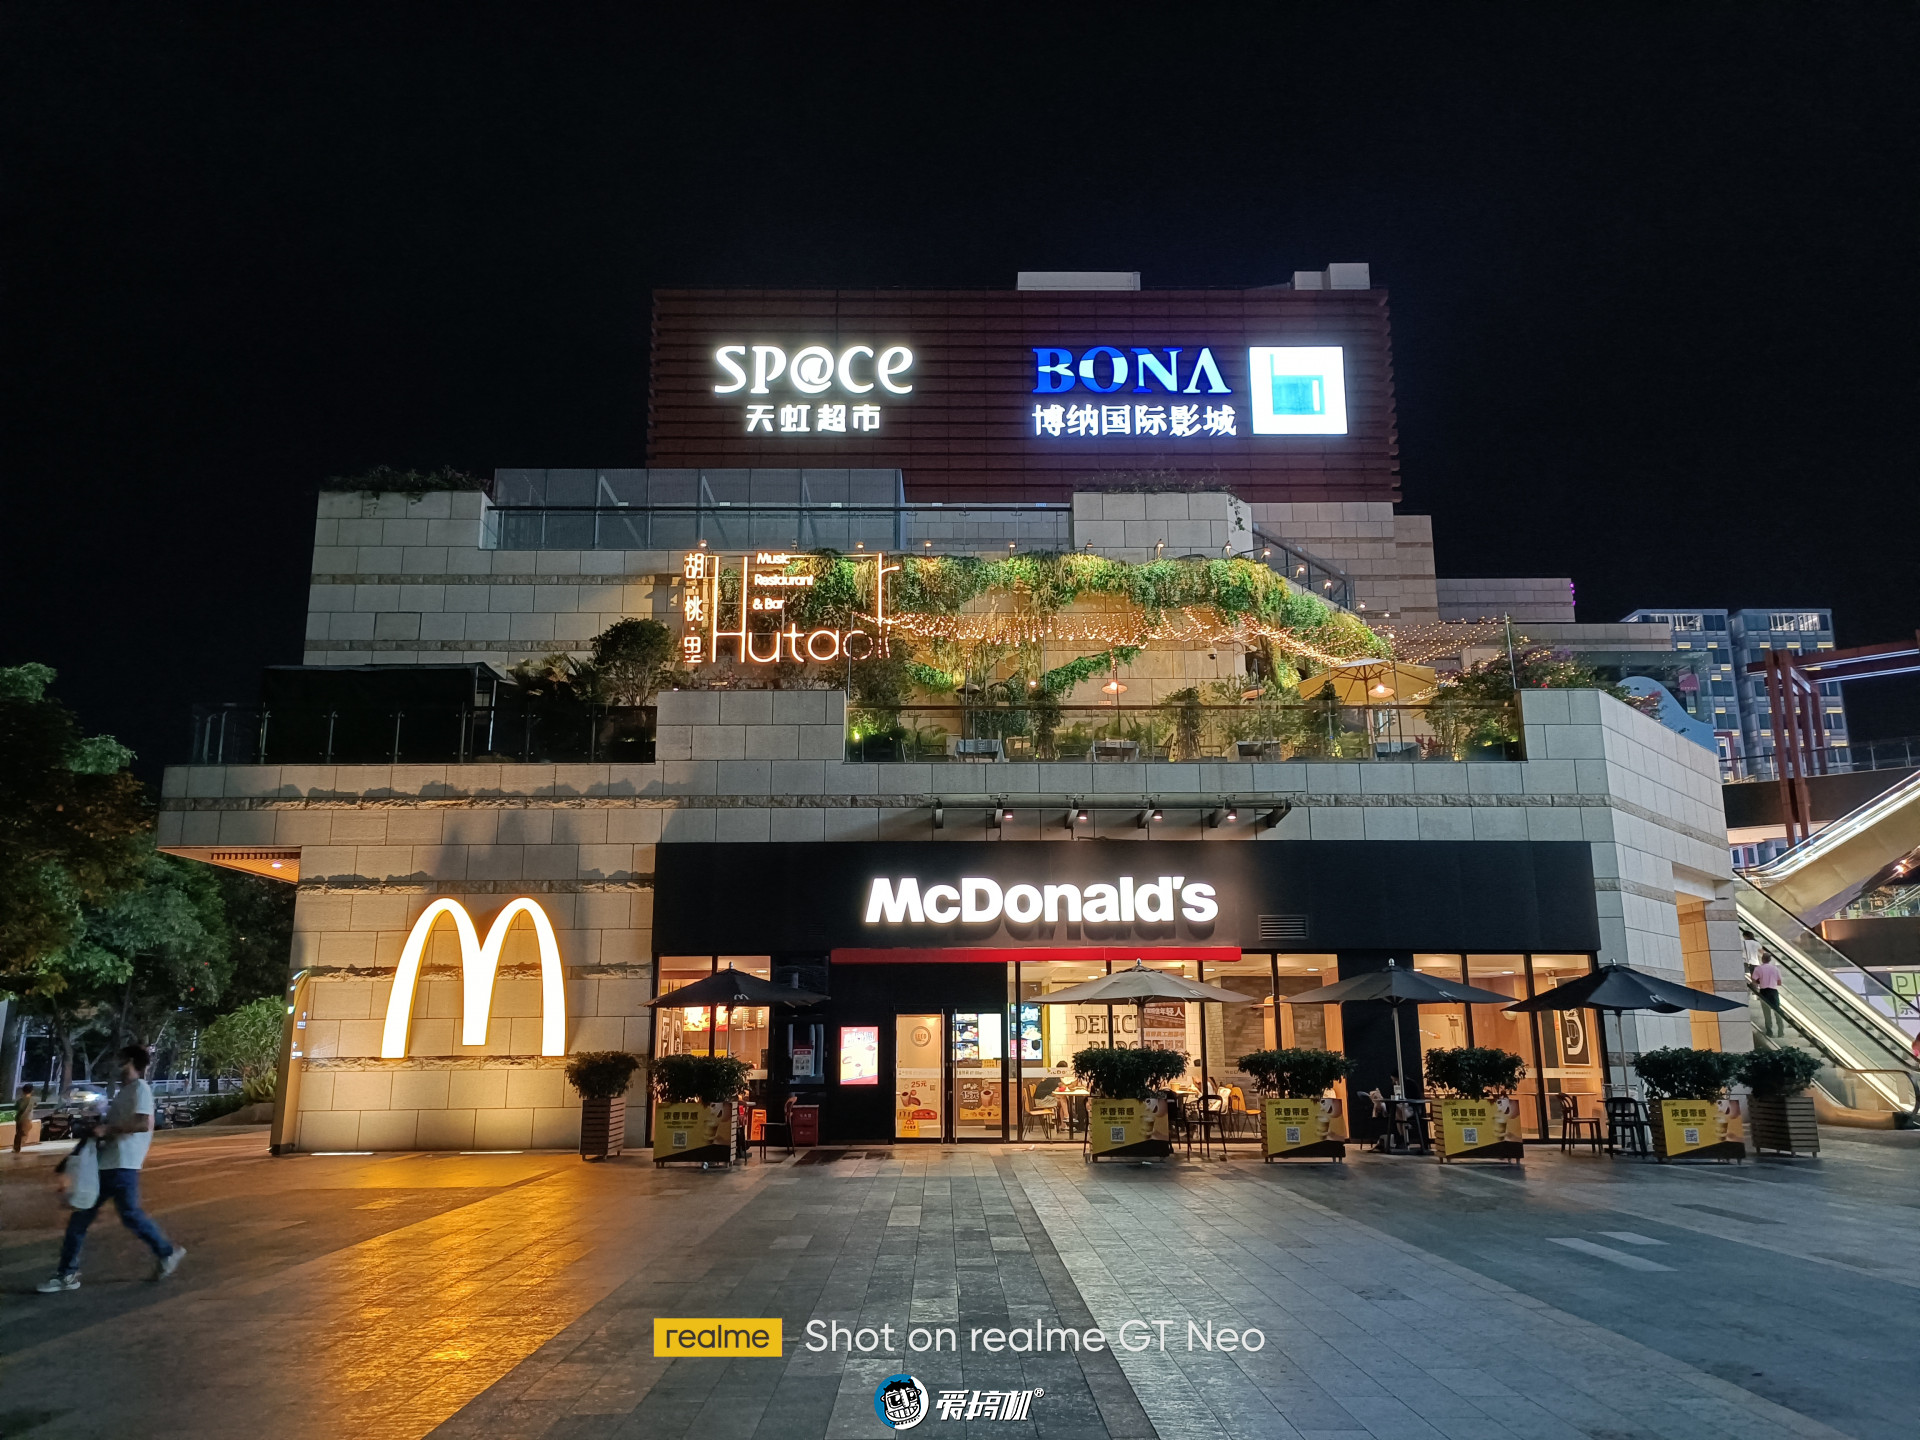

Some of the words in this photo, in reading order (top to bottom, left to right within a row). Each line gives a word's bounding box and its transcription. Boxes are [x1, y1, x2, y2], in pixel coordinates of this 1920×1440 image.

[745, 403, 881, 434] 天虹超市
[1031, 404, 1237, 438] 博纳国际影城
[756, 552, 791, 565] Music
[753, 573, 814, 587] Restaurant
[752, 597, 764, 611] &
[764, 597, 785, 611] Bar
[865, 876, 1219, 924] McDonald's
